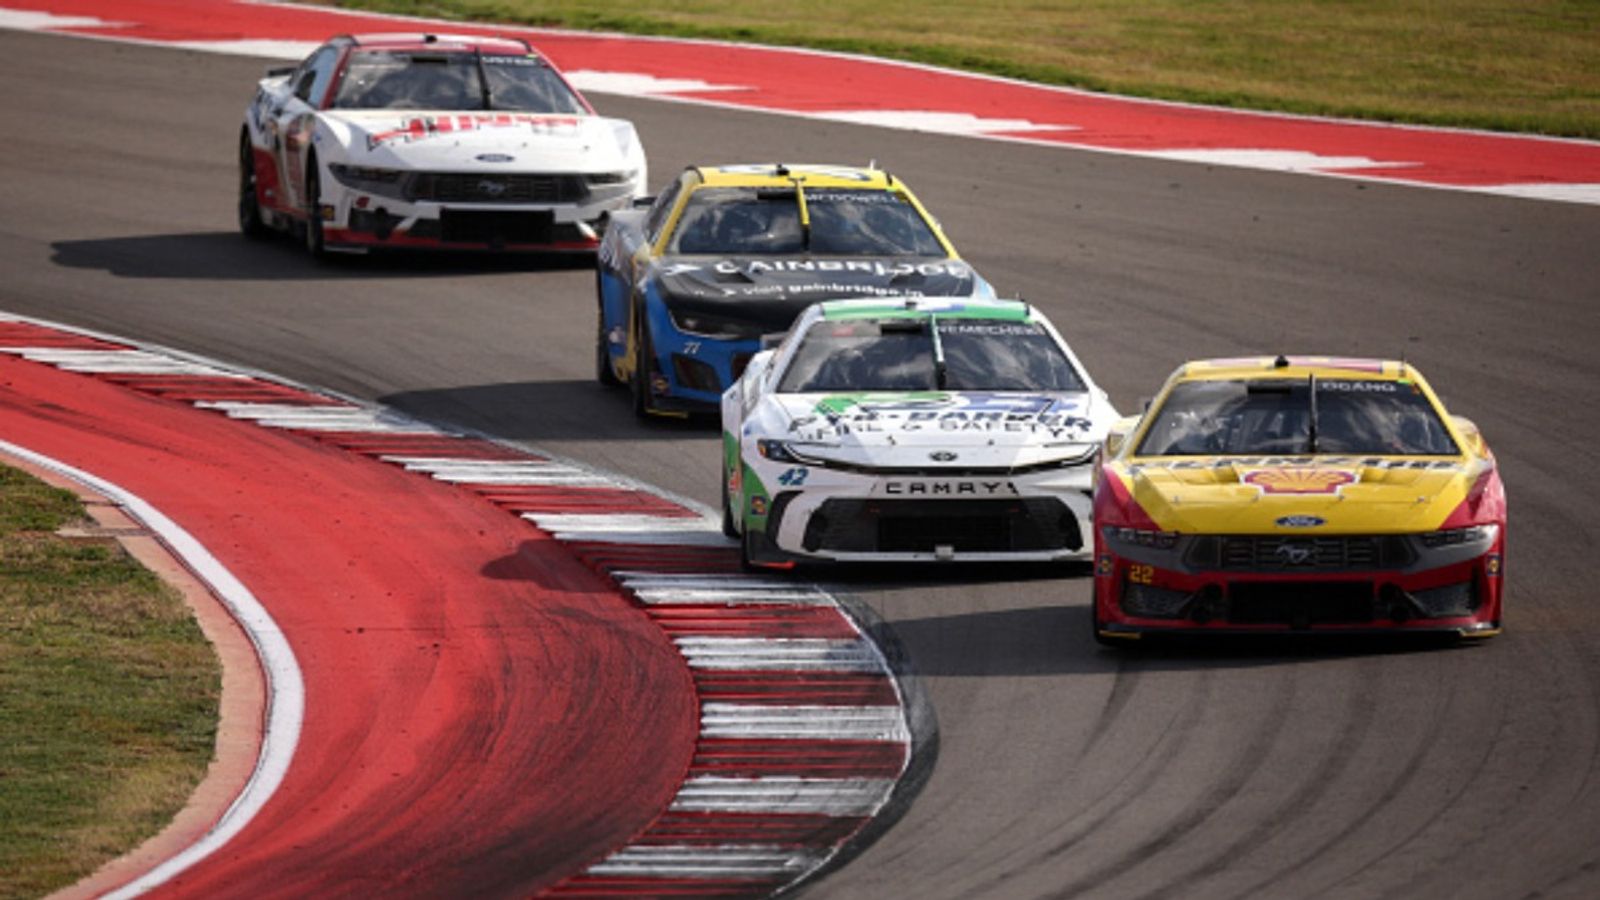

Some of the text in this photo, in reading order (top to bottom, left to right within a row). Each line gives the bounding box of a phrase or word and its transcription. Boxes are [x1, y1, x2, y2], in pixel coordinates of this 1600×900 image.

[684, 341, 702, 354] 77
[778, 467, 809, 486] 42
[1129, 564, 1154, 584] 22
